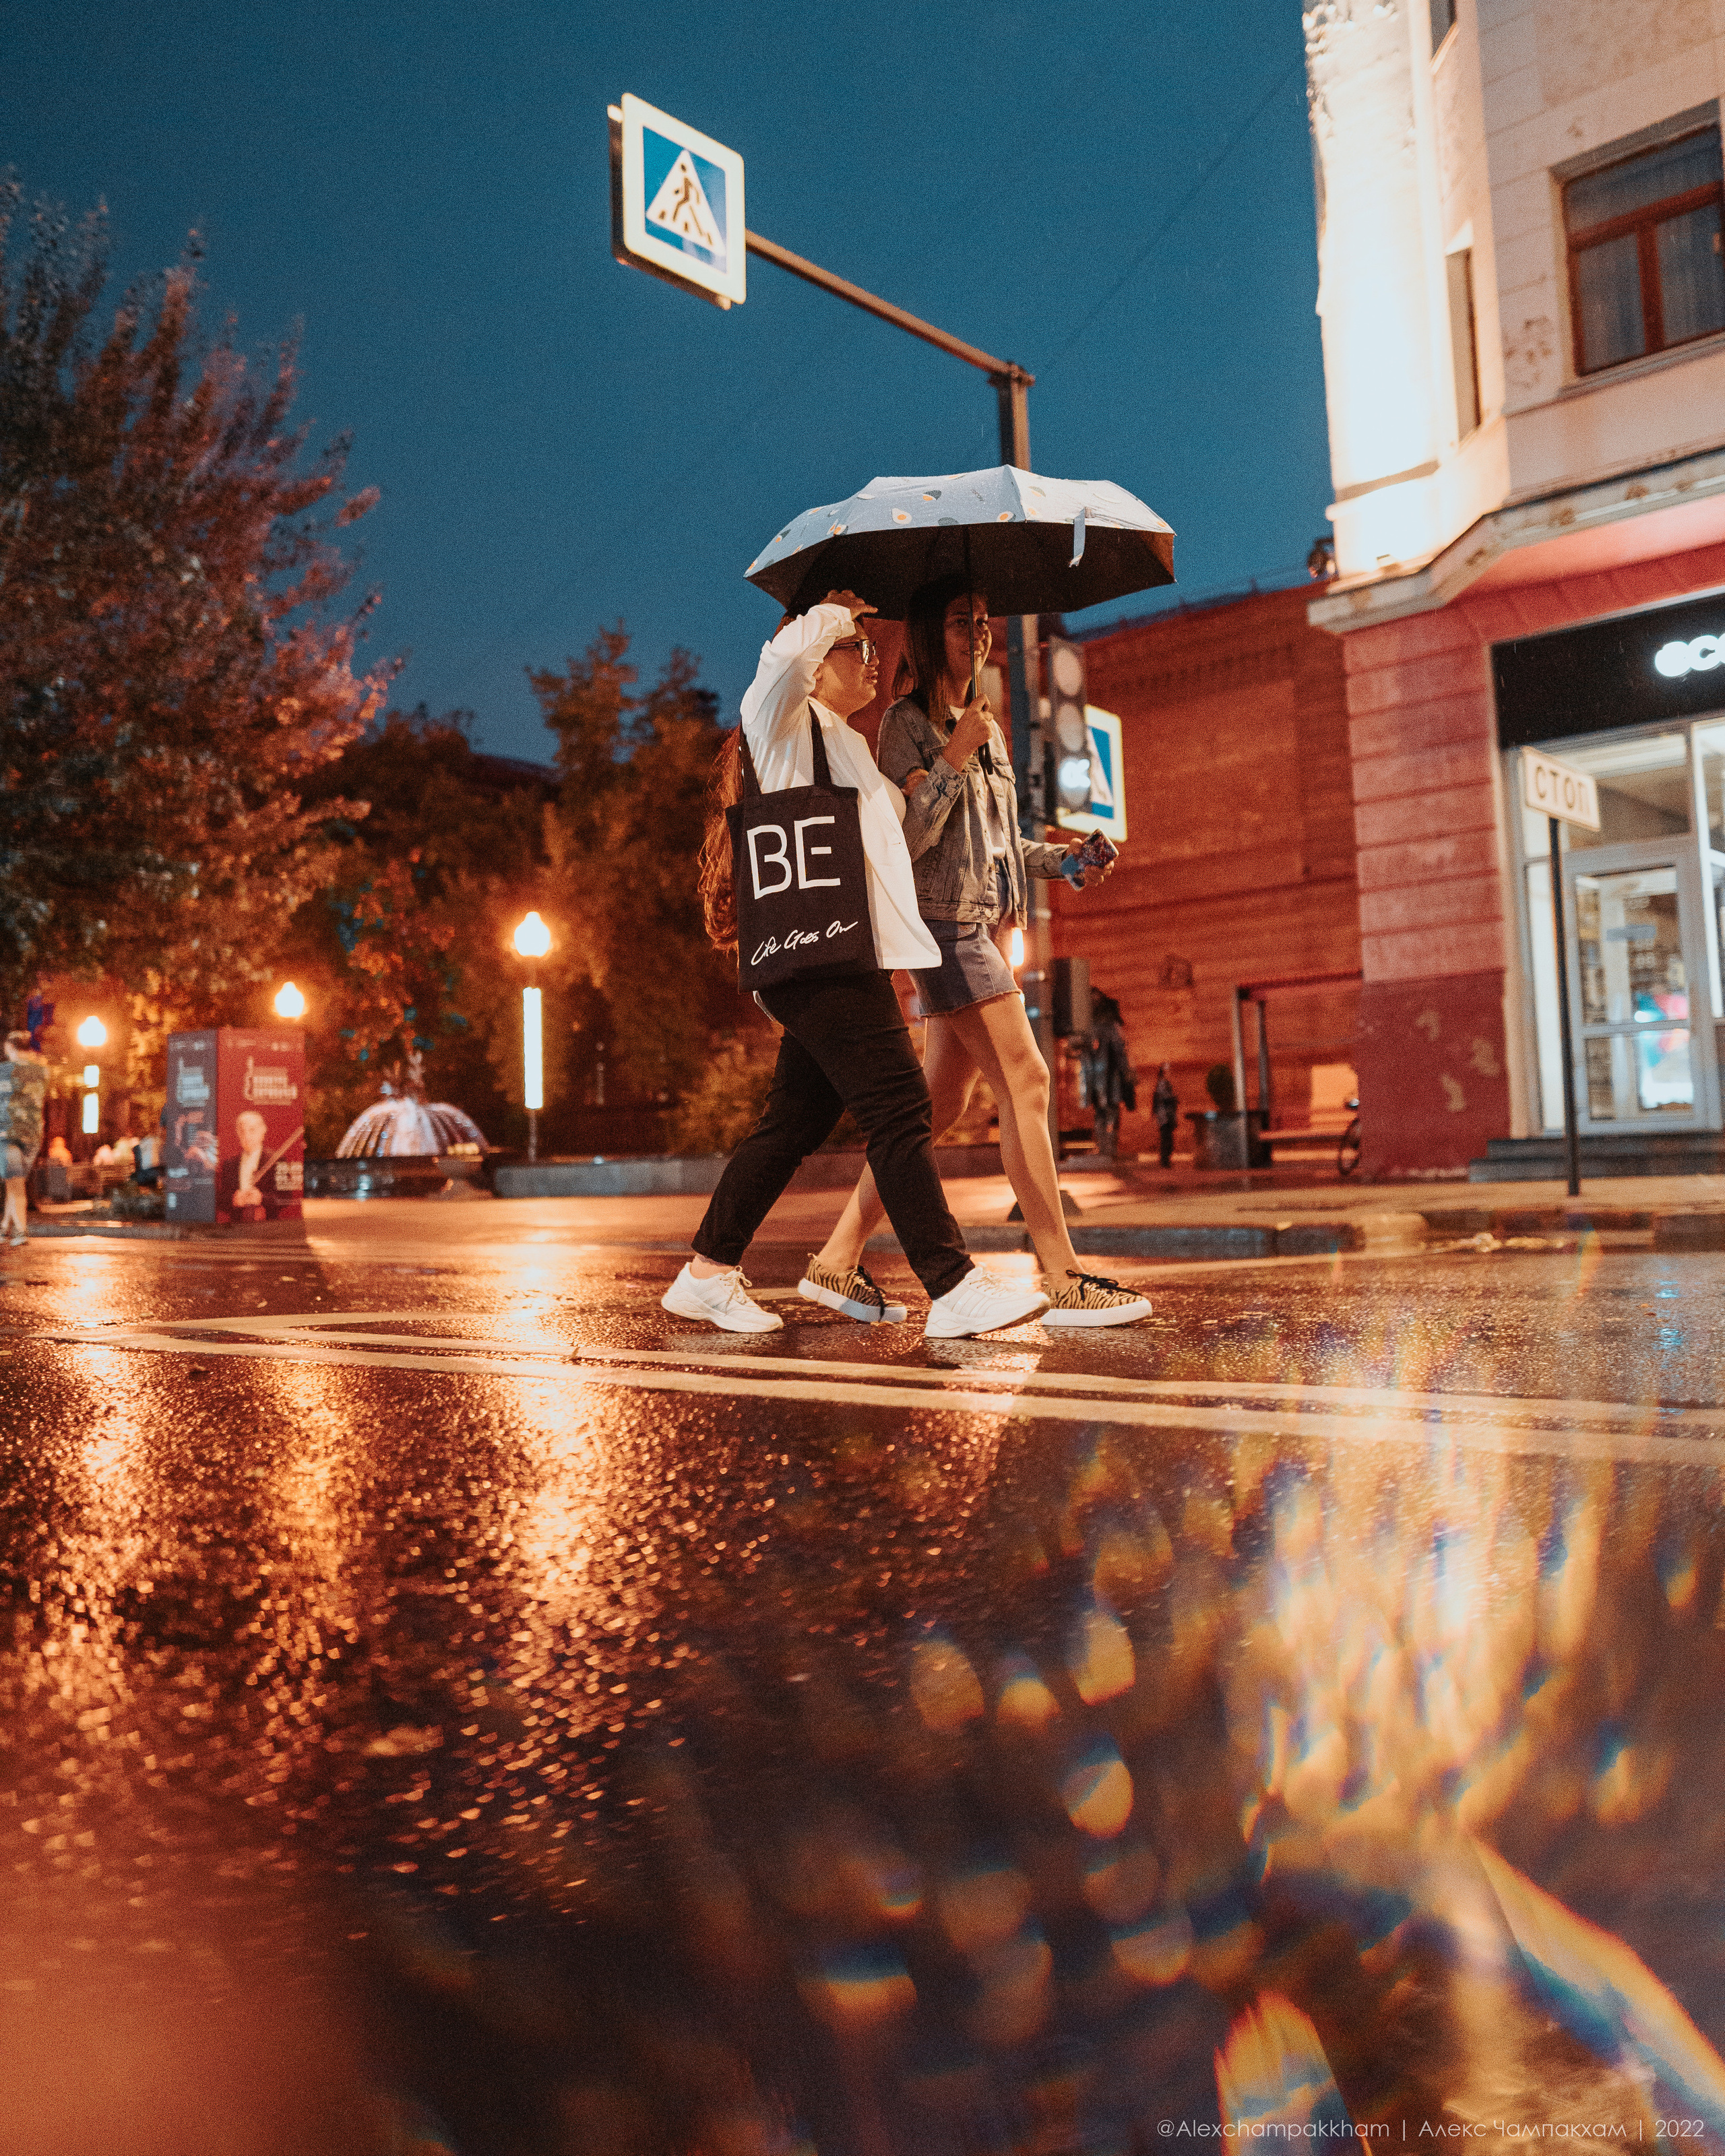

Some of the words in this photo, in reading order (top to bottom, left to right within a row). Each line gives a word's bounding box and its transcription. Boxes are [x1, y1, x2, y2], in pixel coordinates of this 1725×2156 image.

[1534, 765, 1591, 813] СТОП
[747, 816, 841, 900] BE
[751, 937, 782, 965] Life
[784, 930, 820, 950] Goes
[826, 920, 858, 938] On
